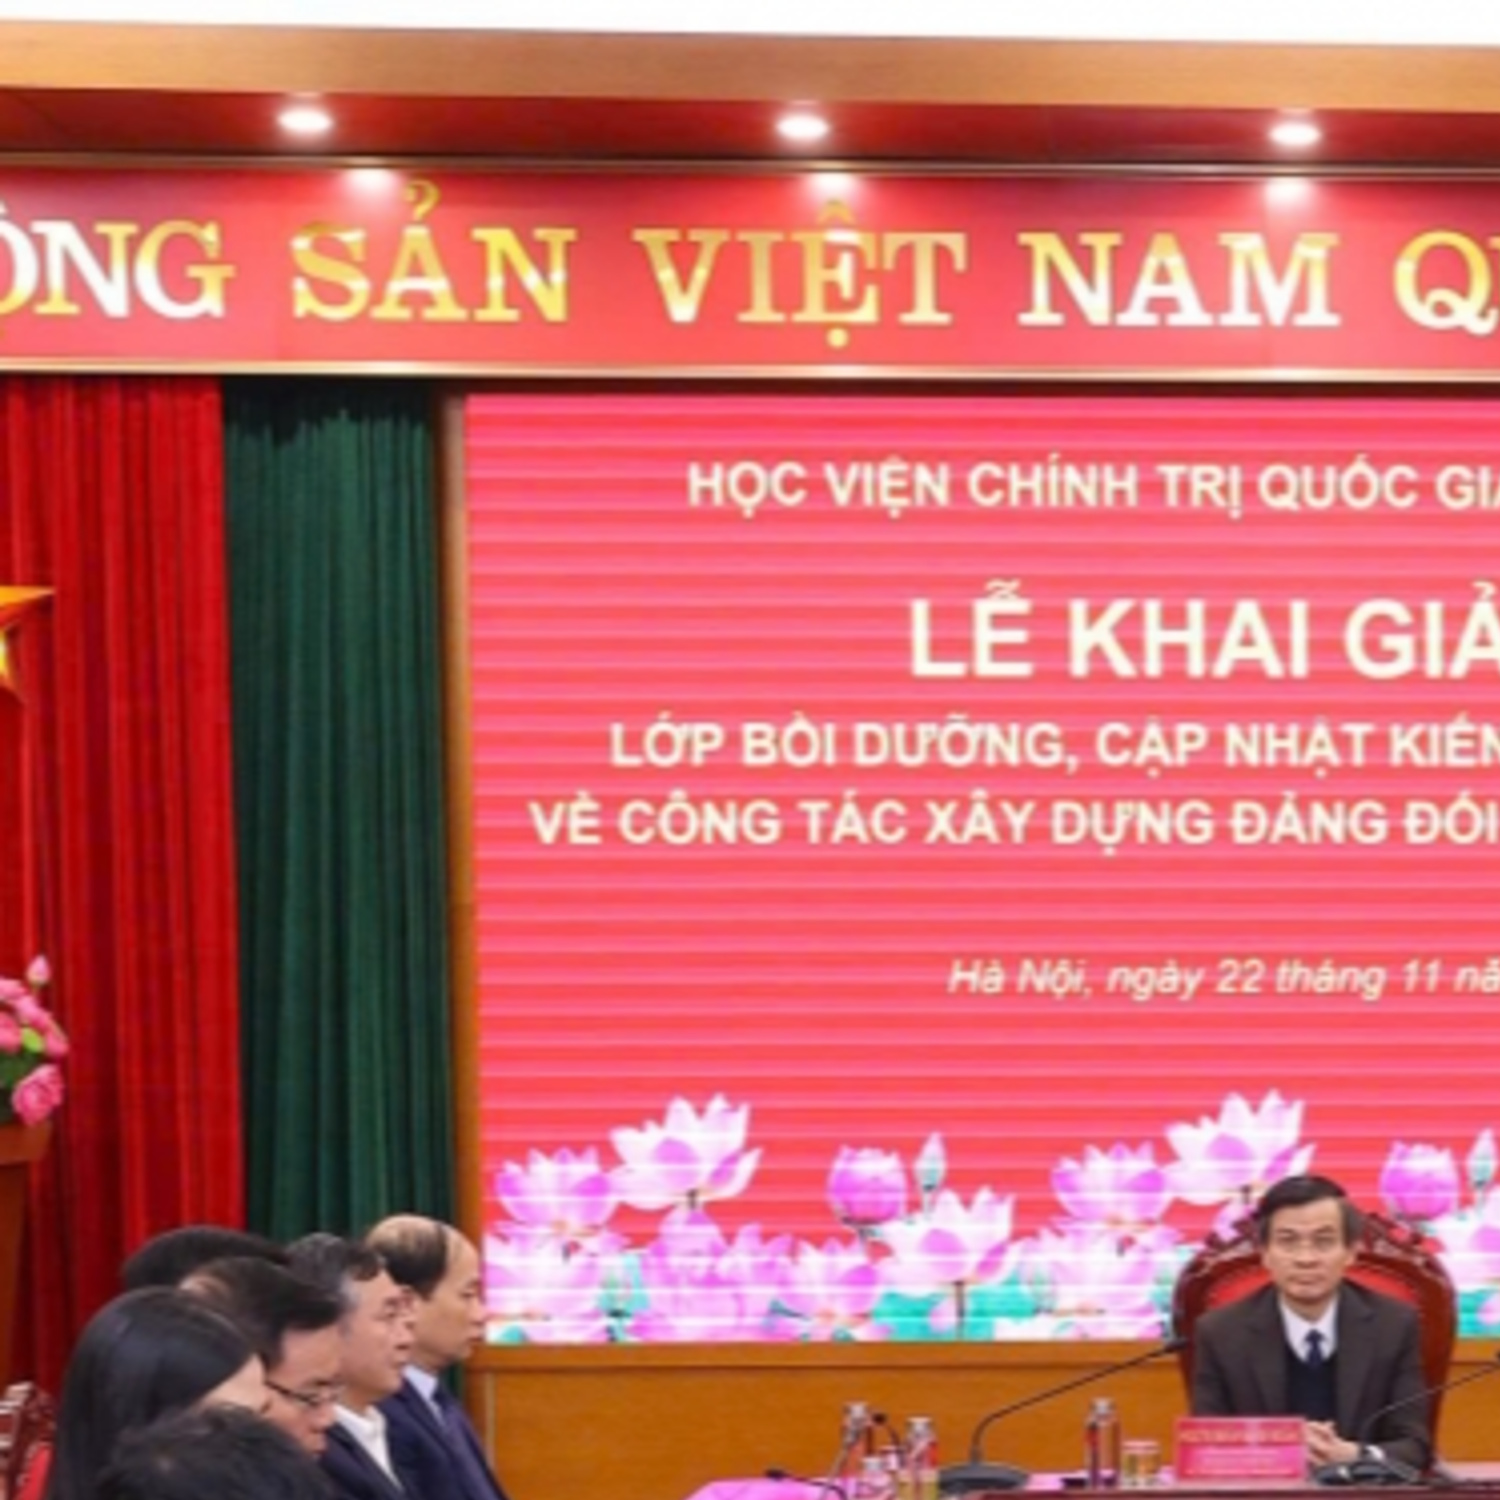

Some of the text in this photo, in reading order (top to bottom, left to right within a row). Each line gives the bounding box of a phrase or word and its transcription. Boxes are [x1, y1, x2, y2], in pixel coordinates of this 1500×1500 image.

[290, 180, 577, 322] SẢN
[633, 198, 968, 348] VIỆT
[1017, 231, 1341, 328] NAM
[687, 461, 806, 519] HỌC
[824, 455, 949, 519] VIỆN
[967, 452, 1139, 505] CHÍNH
[1156, 464, 1243, 520] TRỊ
[909, 579, 1034, 678] LỄ
[1069, 598, 1309, 678] KHAI
[610, 711, 724, 767] LỚP
[854, 713, 1080, 775] DƯỠNG,
[618, 789, 781, 845] CÔNG
[797, 790, 908, 845] TÁC
[924, 788, 1035, 845] XÂY
[1051, 800, 1214, 857] DỰNG
[1230, 790, 1388, 845] ĐẢNG
[947, 958, 1004, 995] Hà
[1016, 958, 1092, 1000] Nội,
[1106, 960, 1203, 1003] ngày
[1216, 958, 1266, 995] 22
[1275, 958, 1386, 1002] tháng
[1402, 958, 1442, 994] 11
